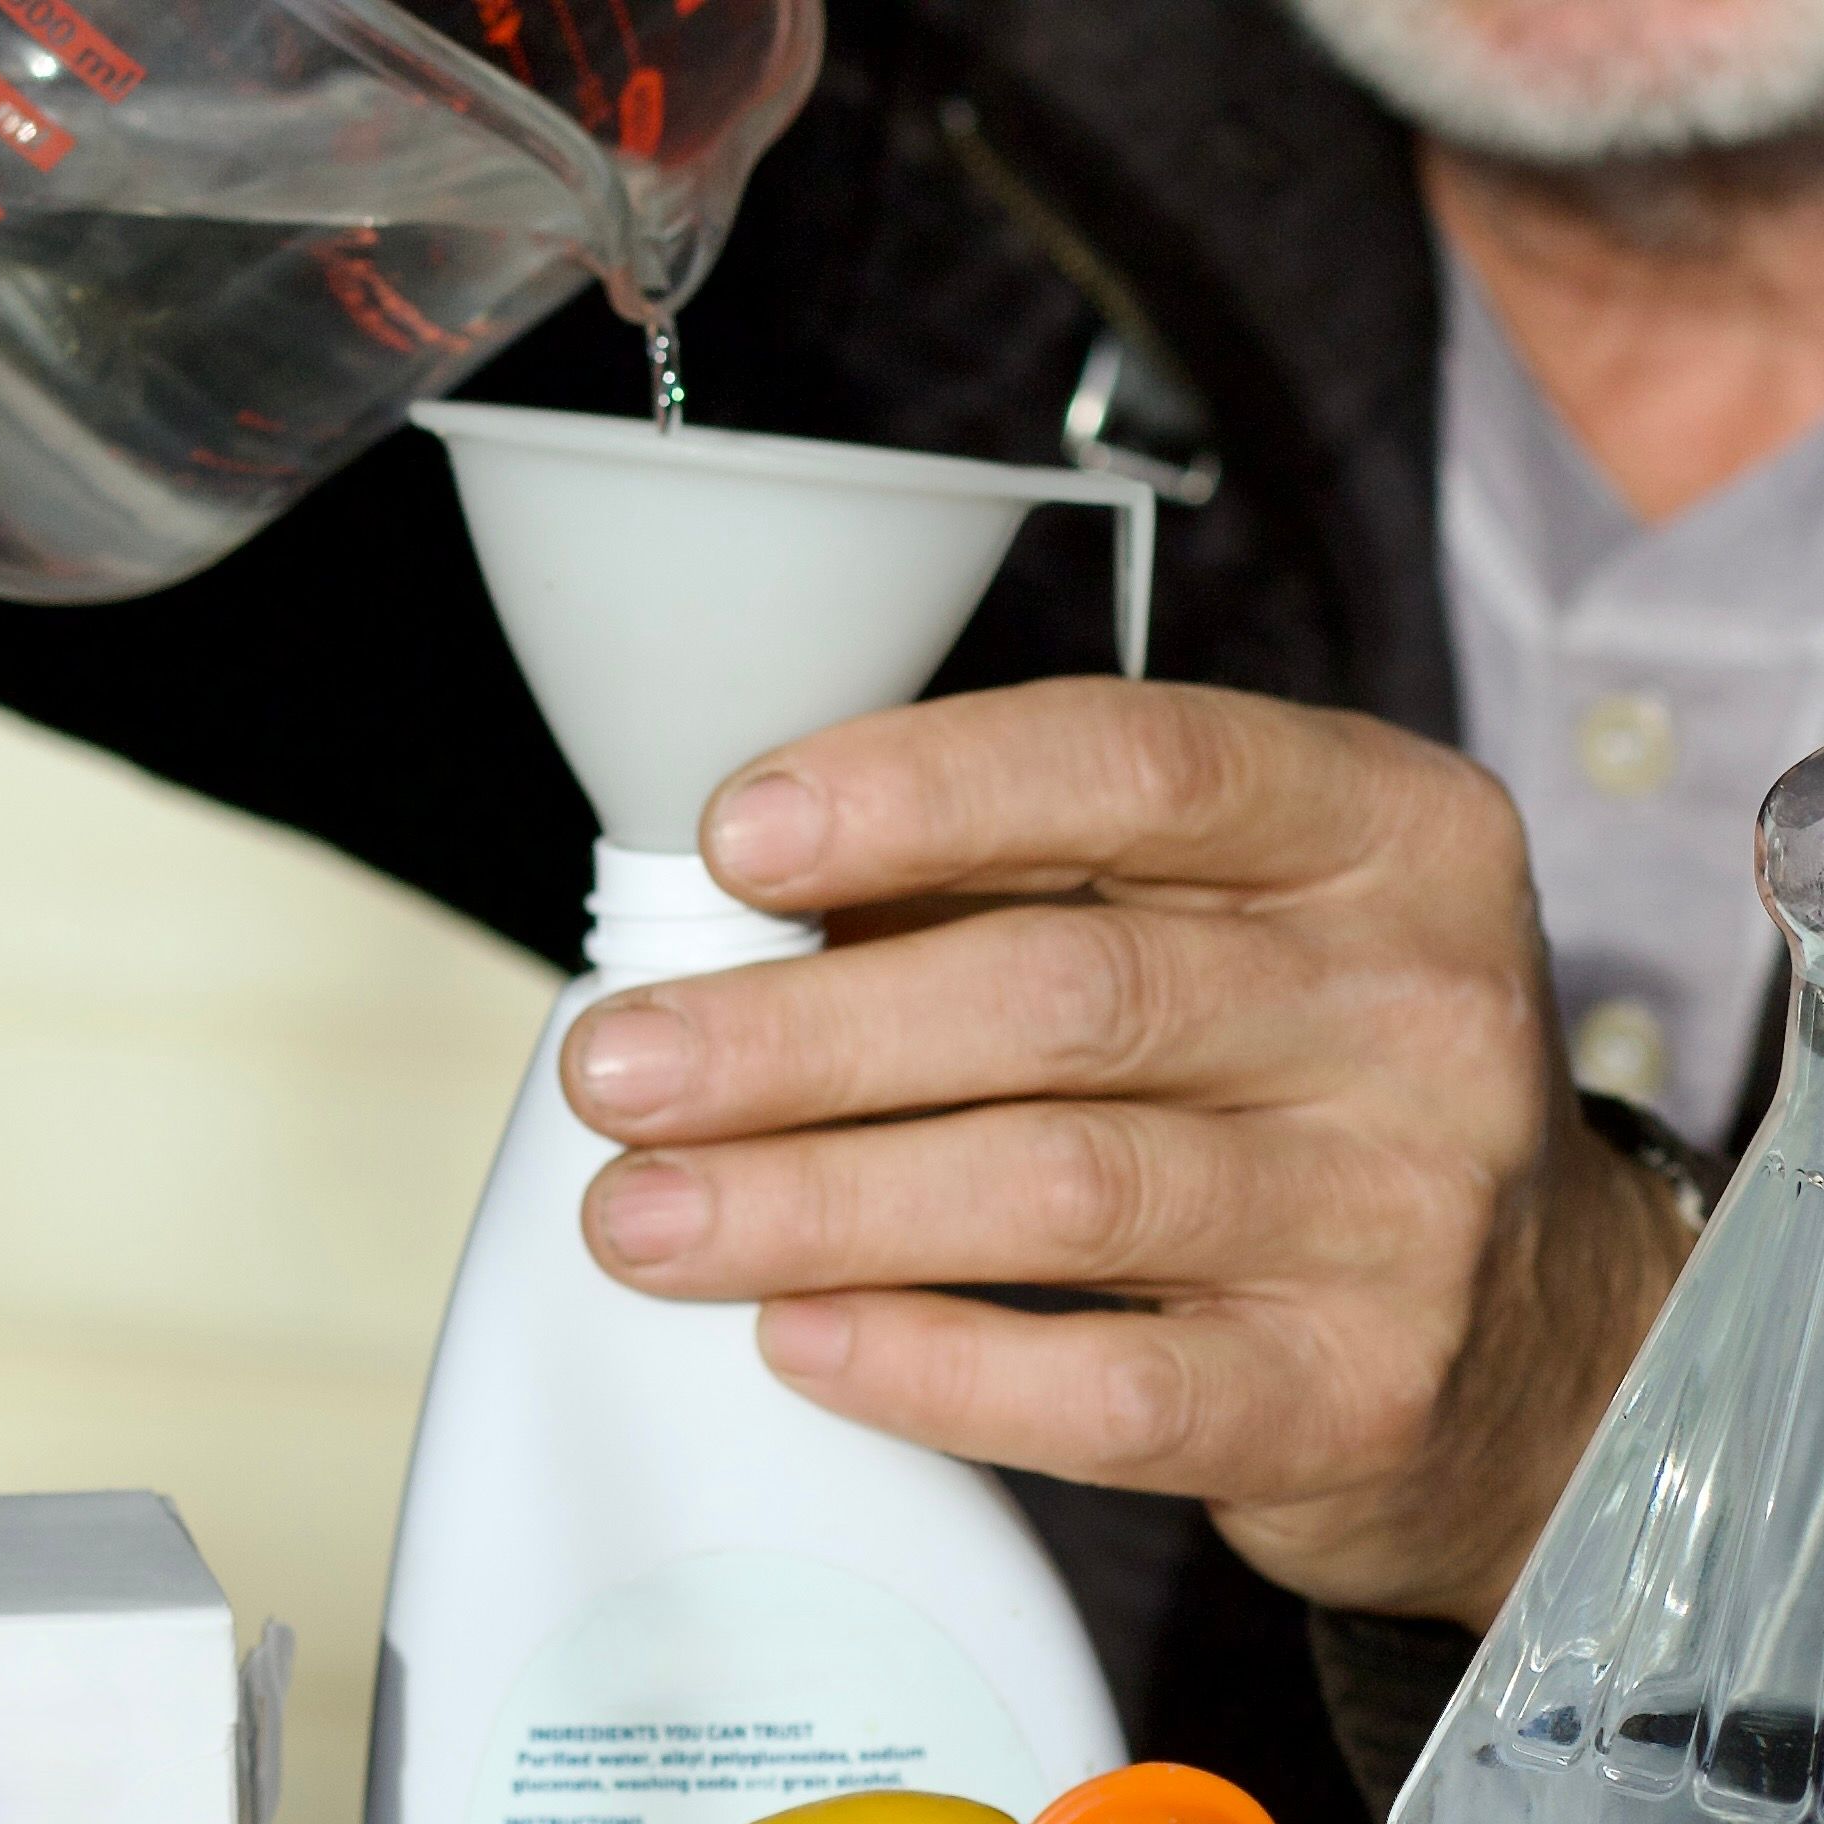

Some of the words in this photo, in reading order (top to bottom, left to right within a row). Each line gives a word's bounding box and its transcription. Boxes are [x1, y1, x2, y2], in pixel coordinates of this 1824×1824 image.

[8, 0, 77, 46] 00
[530, 1725, 658, 1743] INGREDIENTS
[665, 1724, 703, 1741] YOU
[708, 1724, 746, 1740] CAN
[753, 1722, 813, 1740] TRUST
[859, 1745, 926, 1763] sodium
[614, 1776, 690, 1793] washing
[697, 1776, 738, 1791] soda
[783, 1774, 830, 1792] grain
